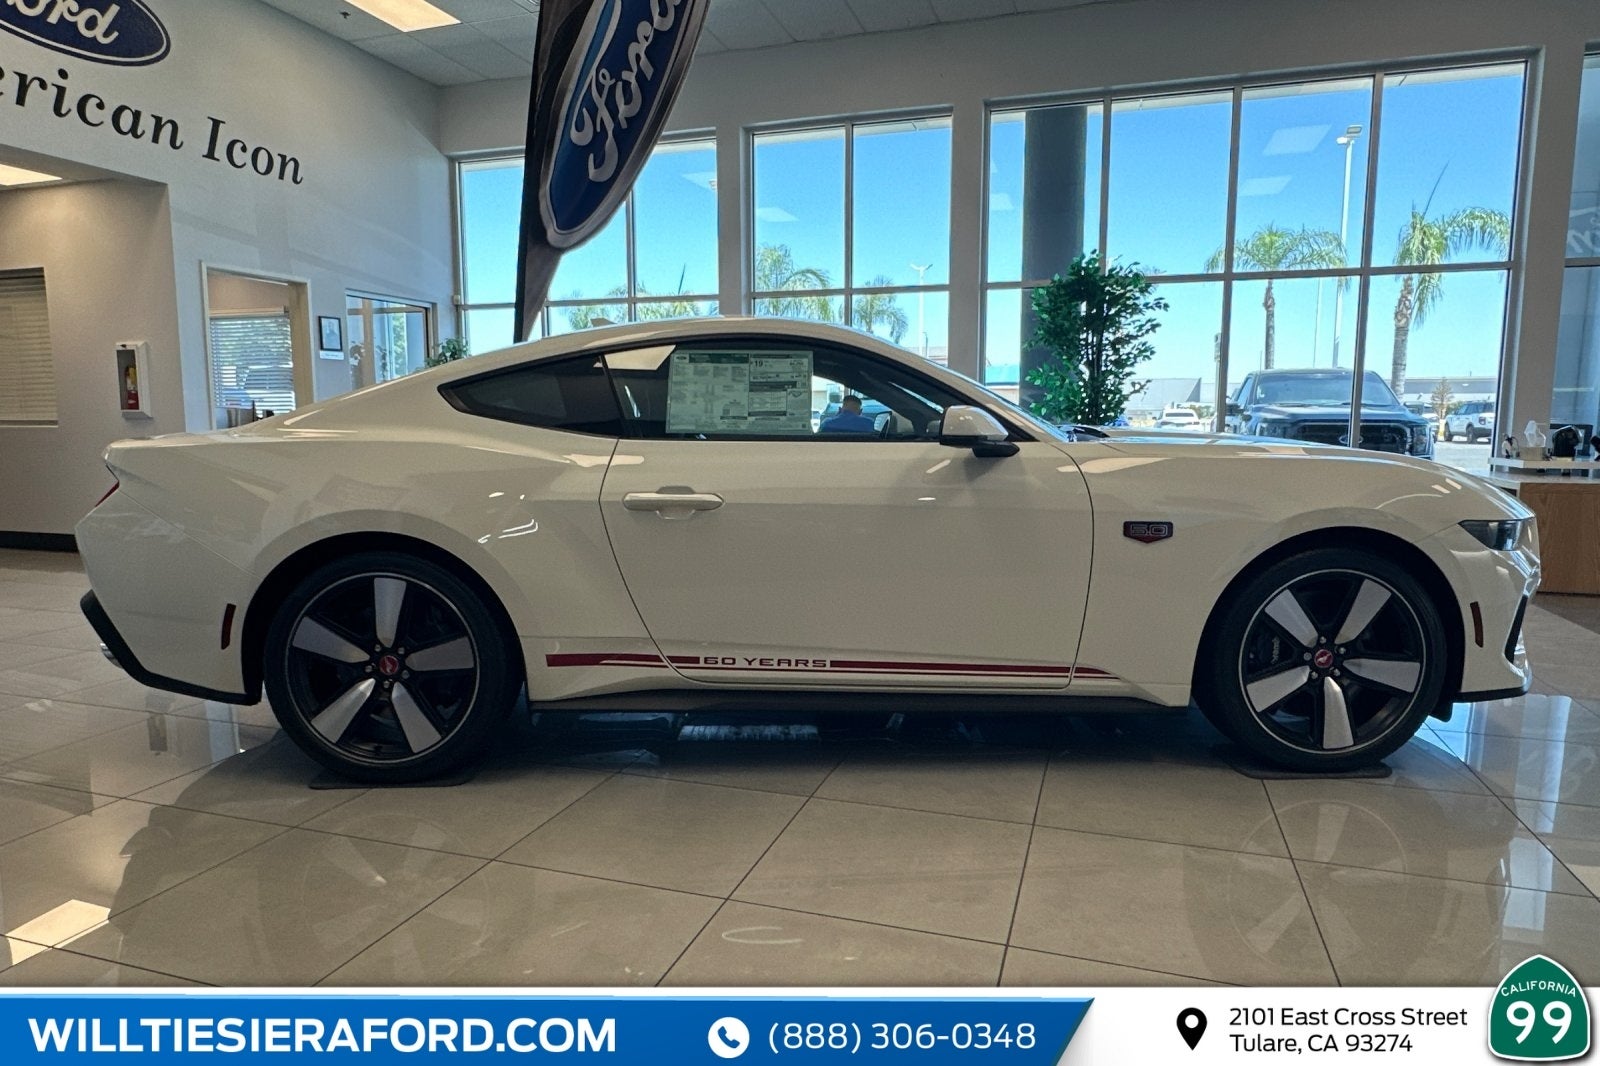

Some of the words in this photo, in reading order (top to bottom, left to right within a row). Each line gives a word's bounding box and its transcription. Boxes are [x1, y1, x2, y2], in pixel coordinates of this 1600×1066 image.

[7, 0, 121, 45] ord
[0, 65, 184, 150] rican
[202, 116, 304, 185] Icon
[703, 656, 737, 666] 60
[743, 657, 827, 668] YEARS
